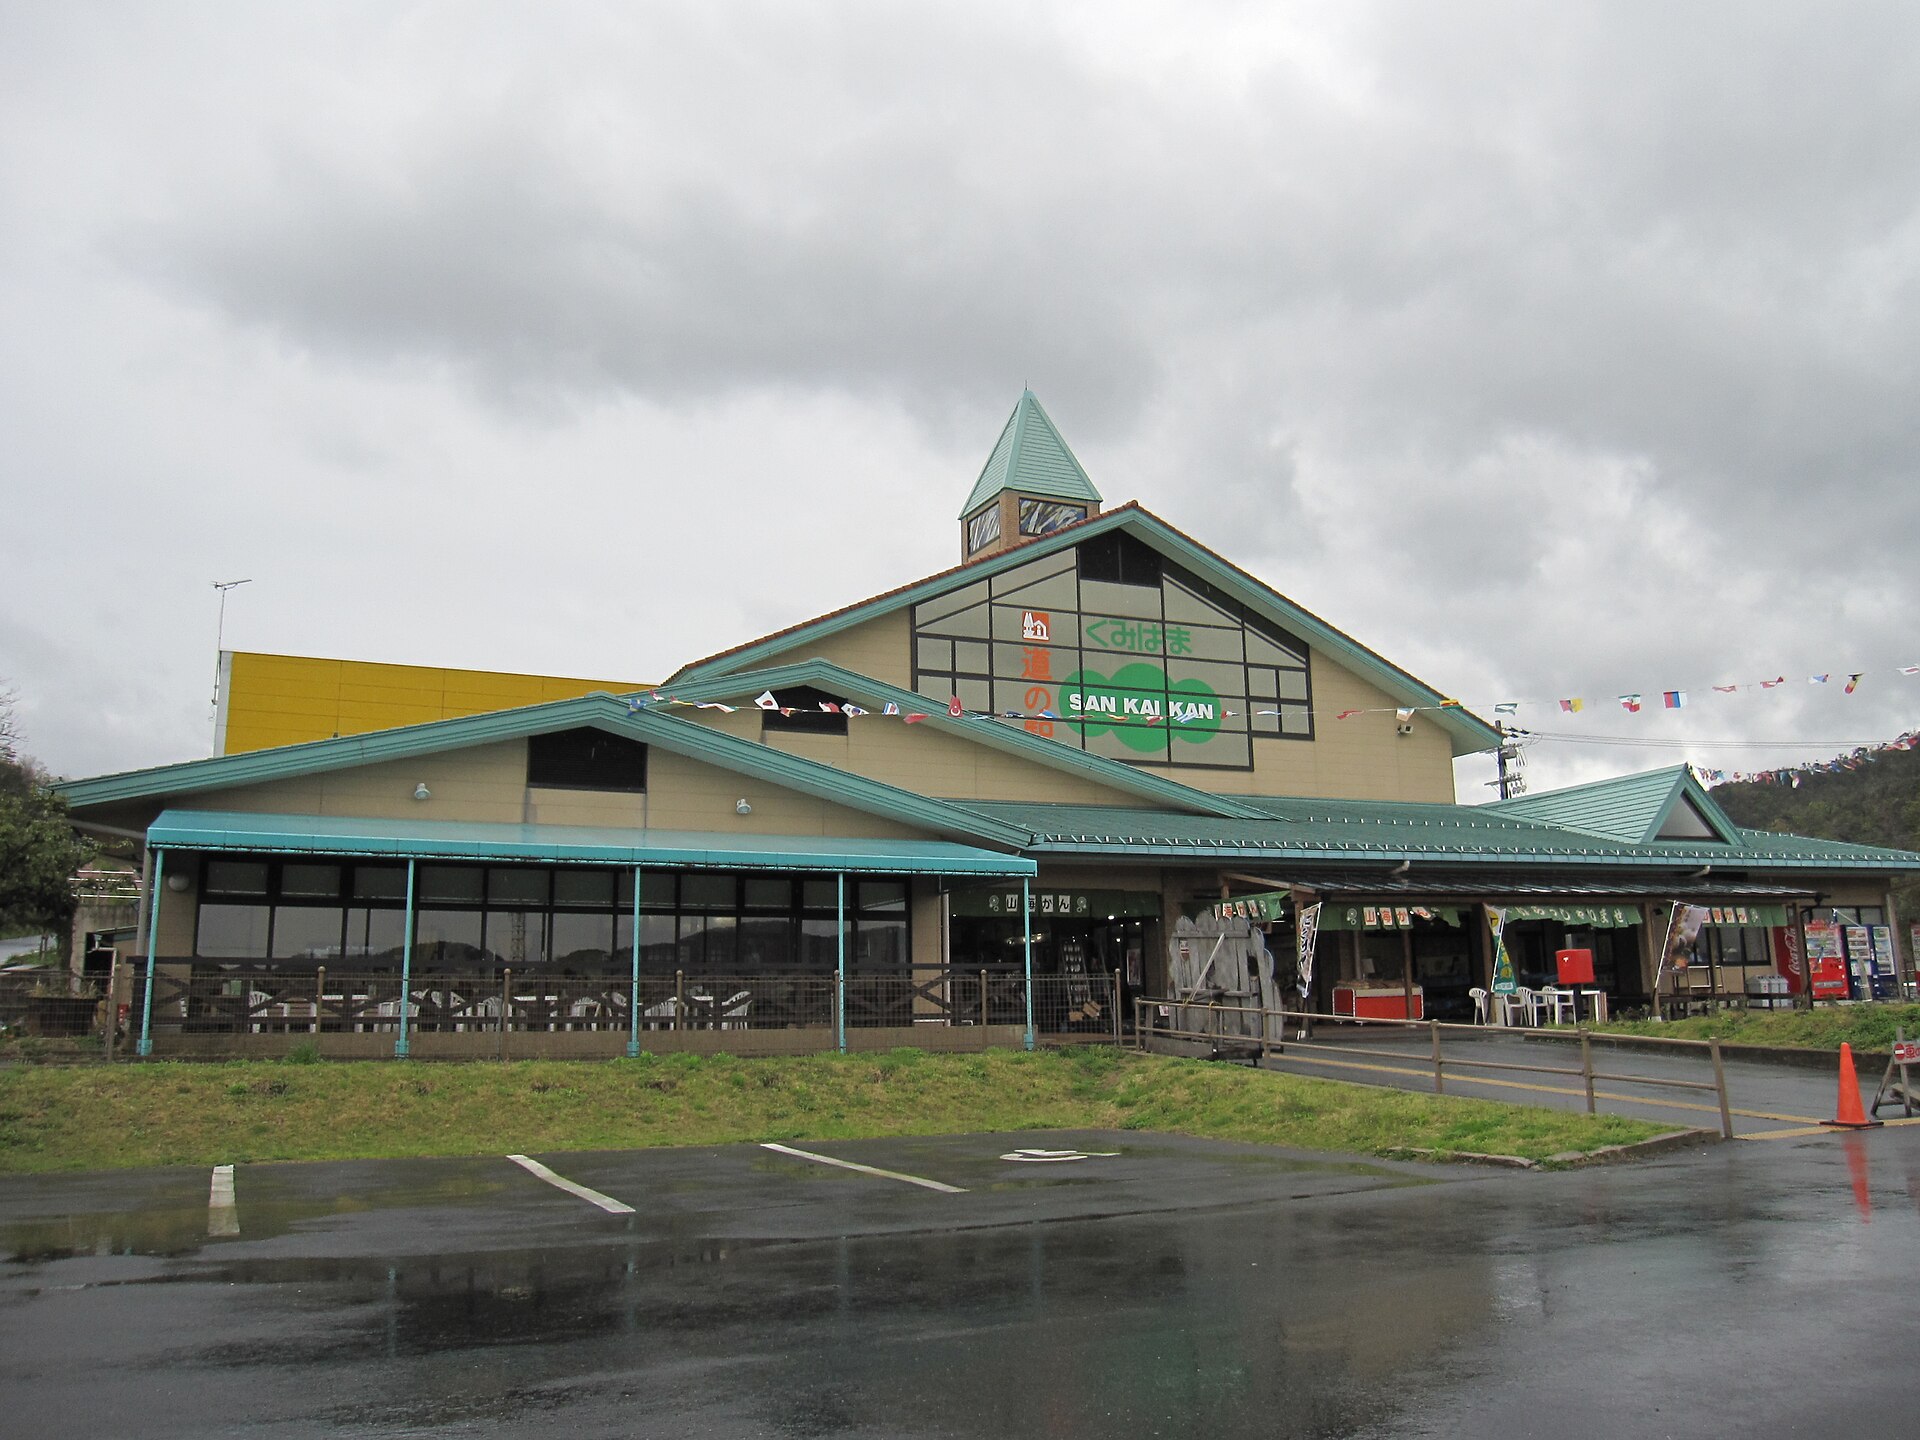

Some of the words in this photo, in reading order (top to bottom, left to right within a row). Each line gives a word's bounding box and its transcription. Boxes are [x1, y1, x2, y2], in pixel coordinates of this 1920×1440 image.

[1085, 619, 1192, 655] くみはま
[1069, 693, 1116, 713] SAN
[1123, 697, 1160, 716] KAI
[1169, 701, 1213, 720] KAN
